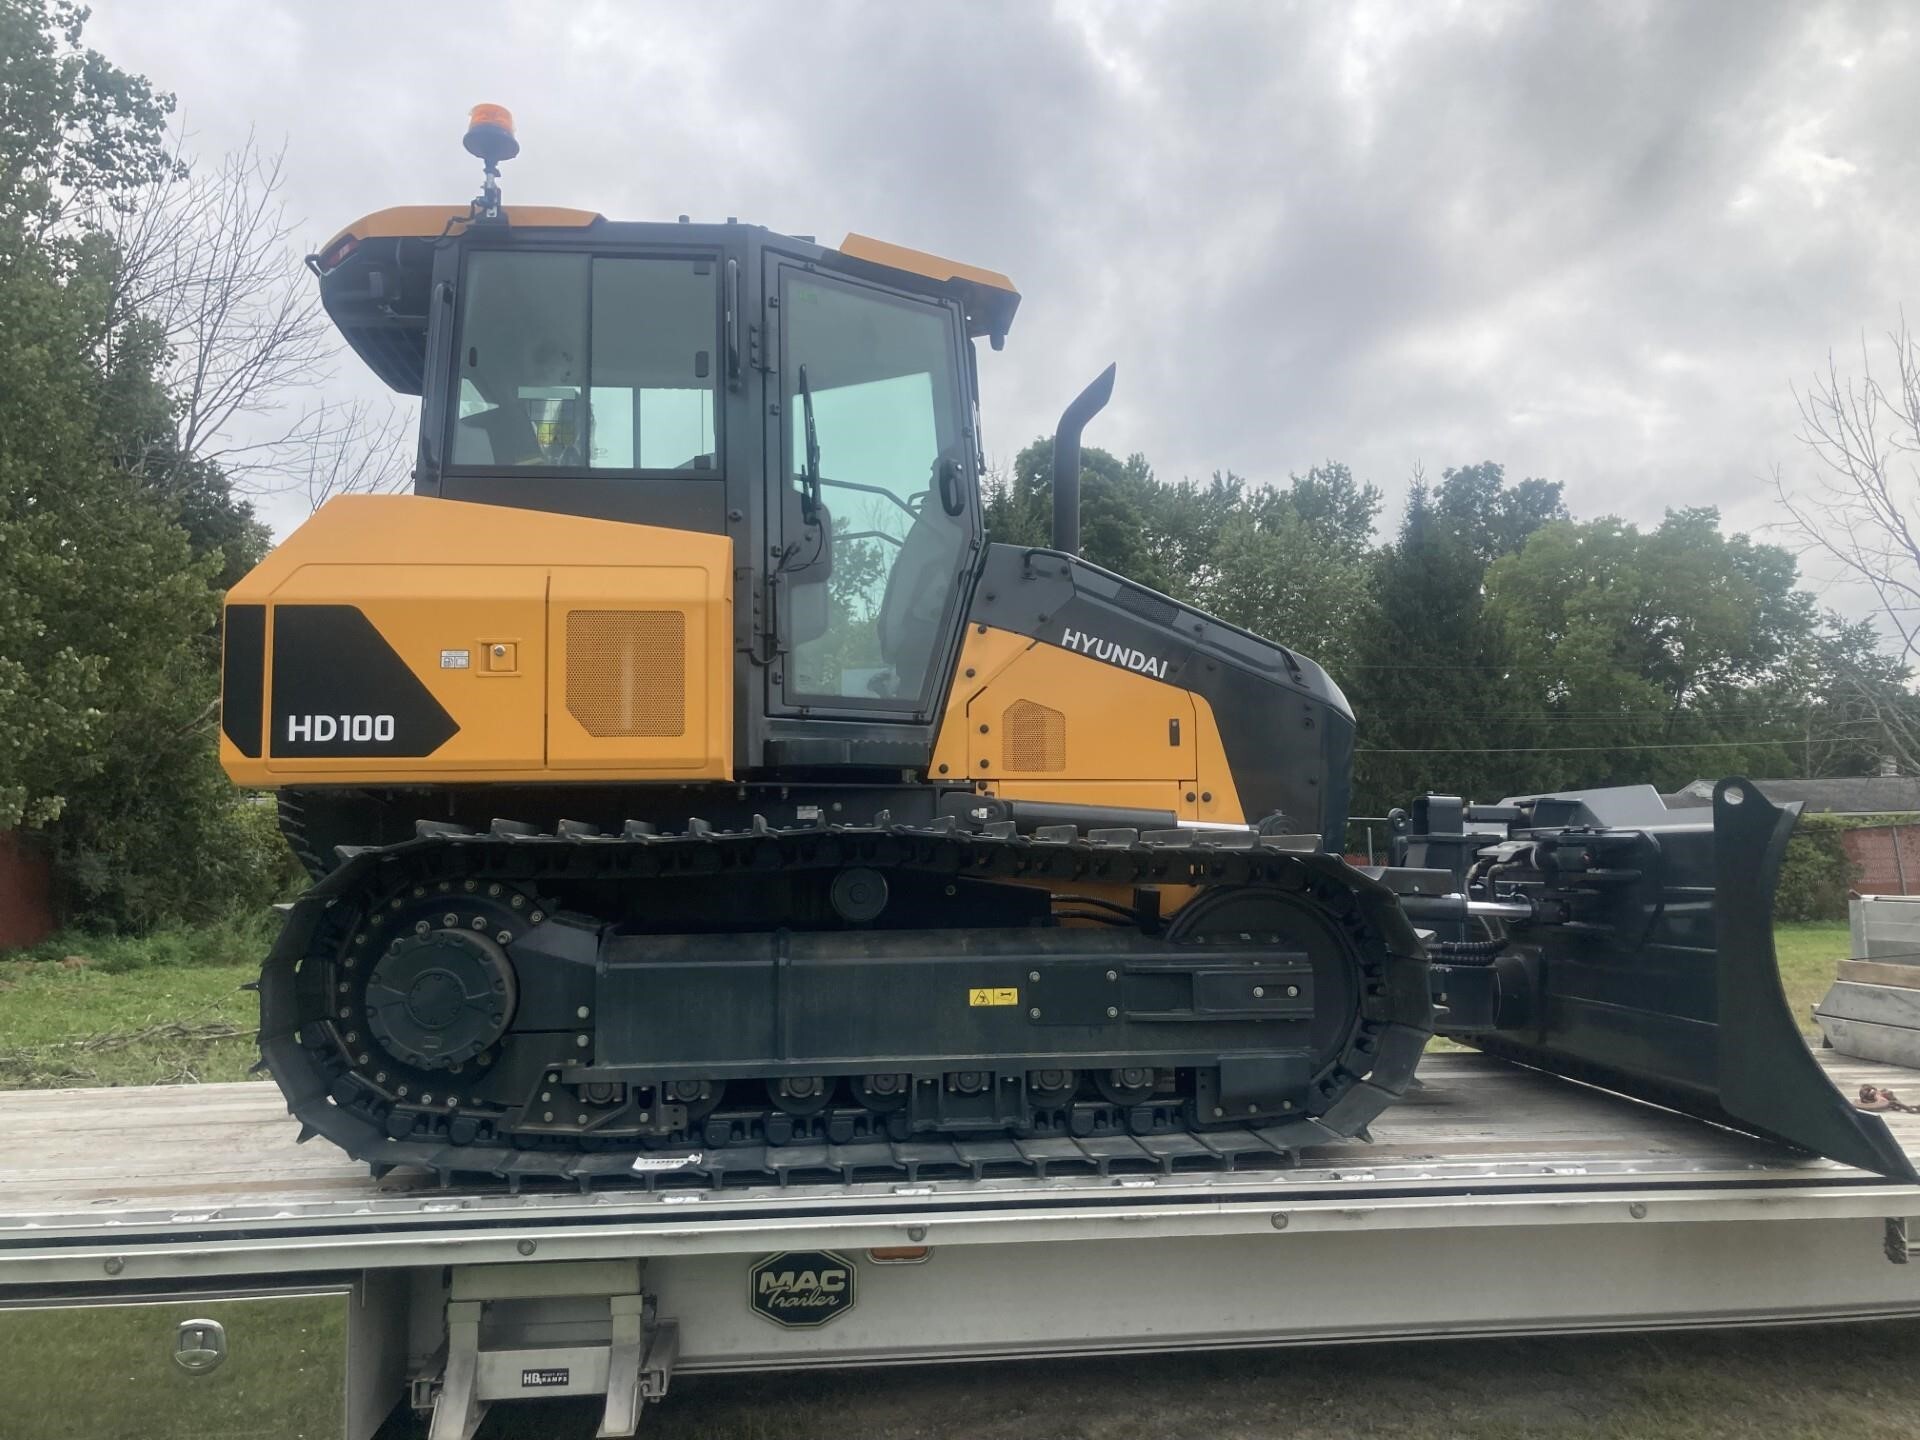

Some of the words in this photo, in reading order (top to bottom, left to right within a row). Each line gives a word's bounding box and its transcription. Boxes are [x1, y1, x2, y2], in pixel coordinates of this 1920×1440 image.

[1061, 627, 1168, 679] HYUNDAI
[288, 715, 395, 742] HD100
[759, 1270, 846, 1293] MAC
[765, 1286, 840, 1308] Trailer
